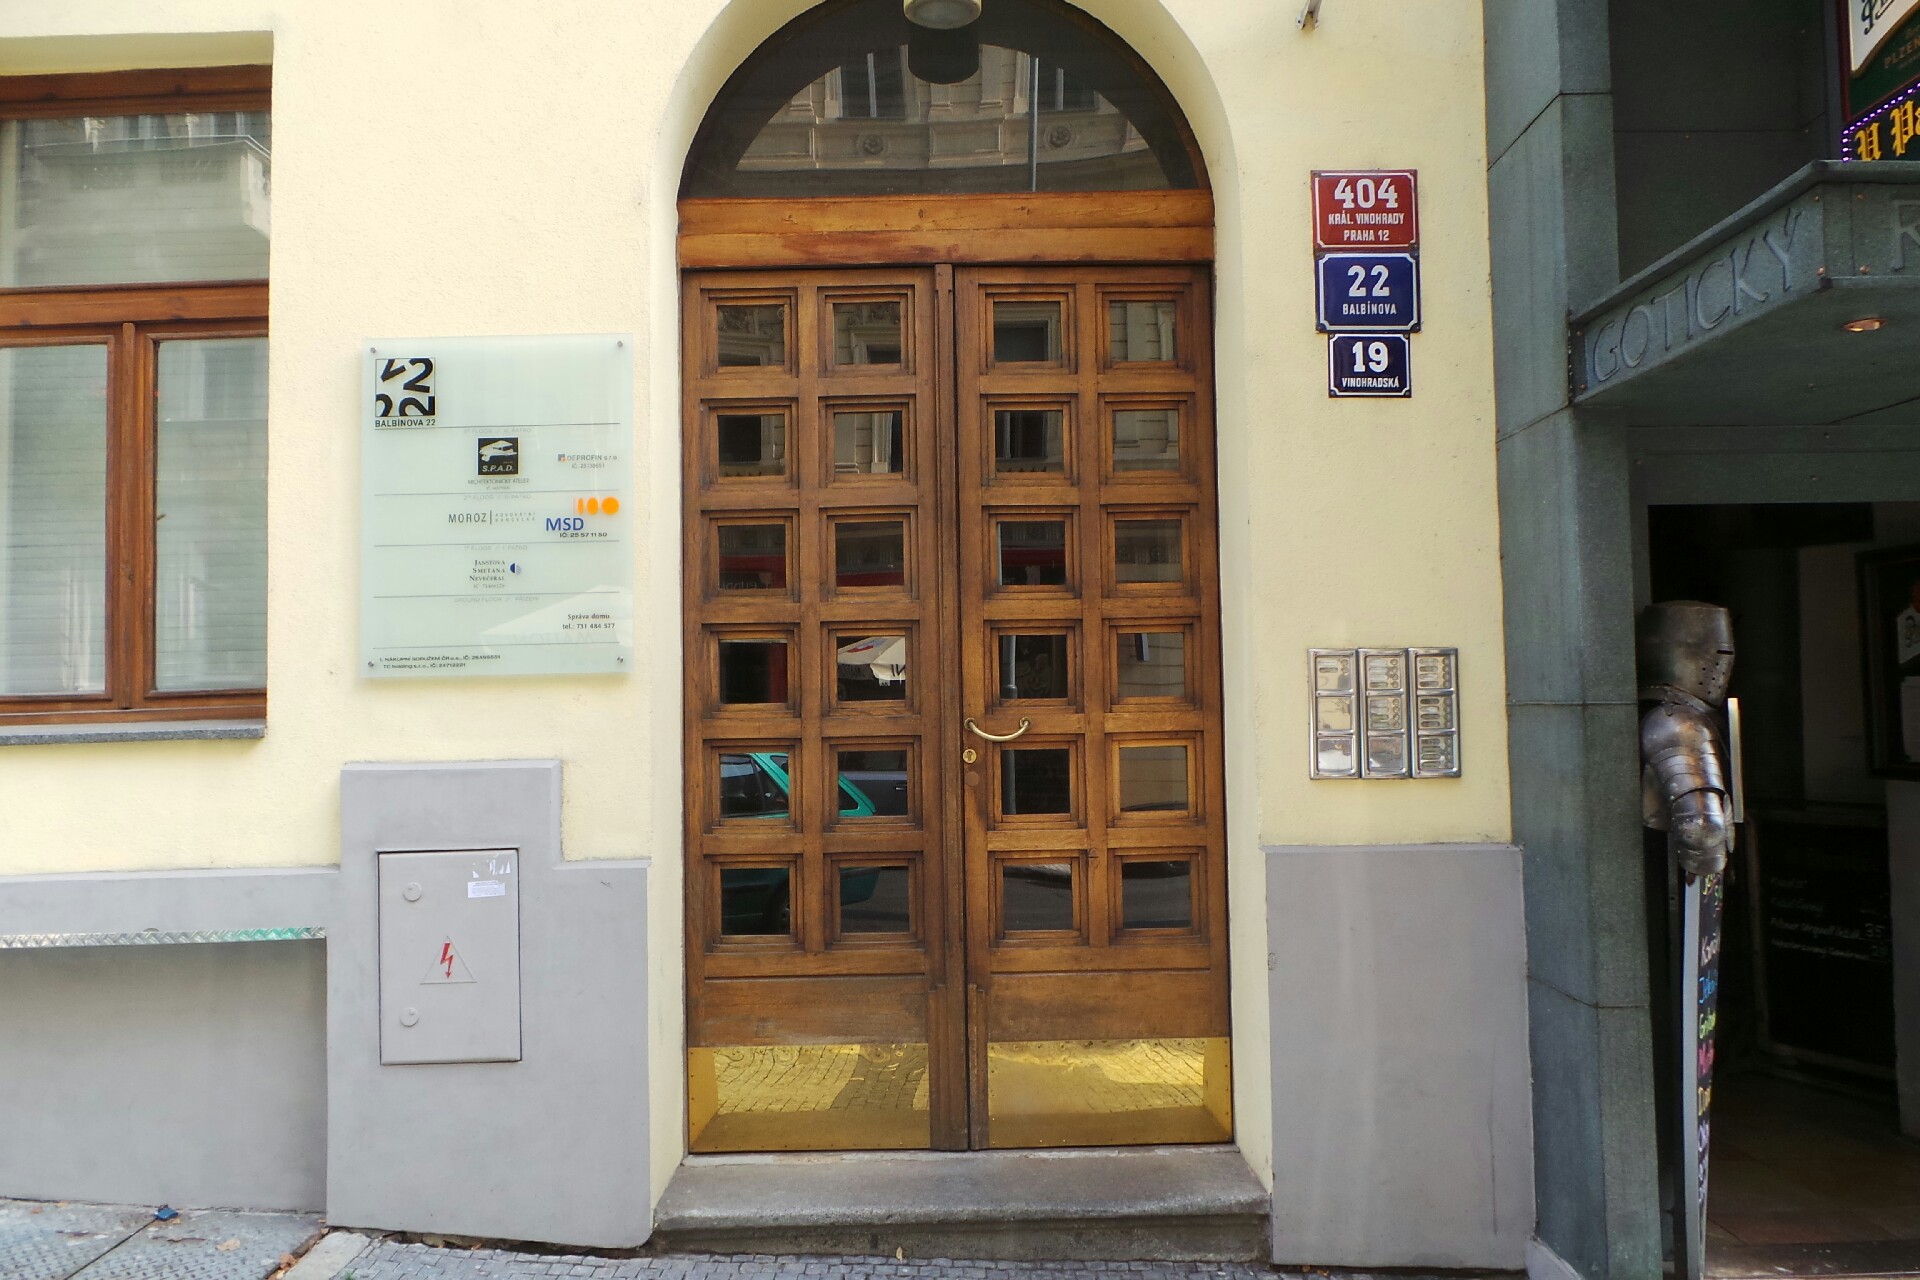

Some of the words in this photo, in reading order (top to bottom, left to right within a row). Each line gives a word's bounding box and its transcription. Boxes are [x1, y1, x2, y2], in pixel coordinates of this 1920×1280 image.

[1334, 178, 1398, 209] 404
[1328, 210, 1354, 225] KRÁL.
[1356, 212, 1405, 225] VINOHRADY
[1343, 229, 1375, 241] PRAHA
[1377, 229, 1390, 241] 12
[1347, 265, 1389, 297] 22
[1342, 301, 1397, 315] BALBÍNOVA
[1352, 341, 1389, 373] 19
[1341, 376, 1400, 388] VINOHRADSKÁ
[375, 418, 424, 428] BALBÍNOVA
[426, 418, 436, 427] 22
[448, 512, 487, 523] MOROZ
[546, 517, 585, 531] MSD
[567, 613, 590, 621] Správa
